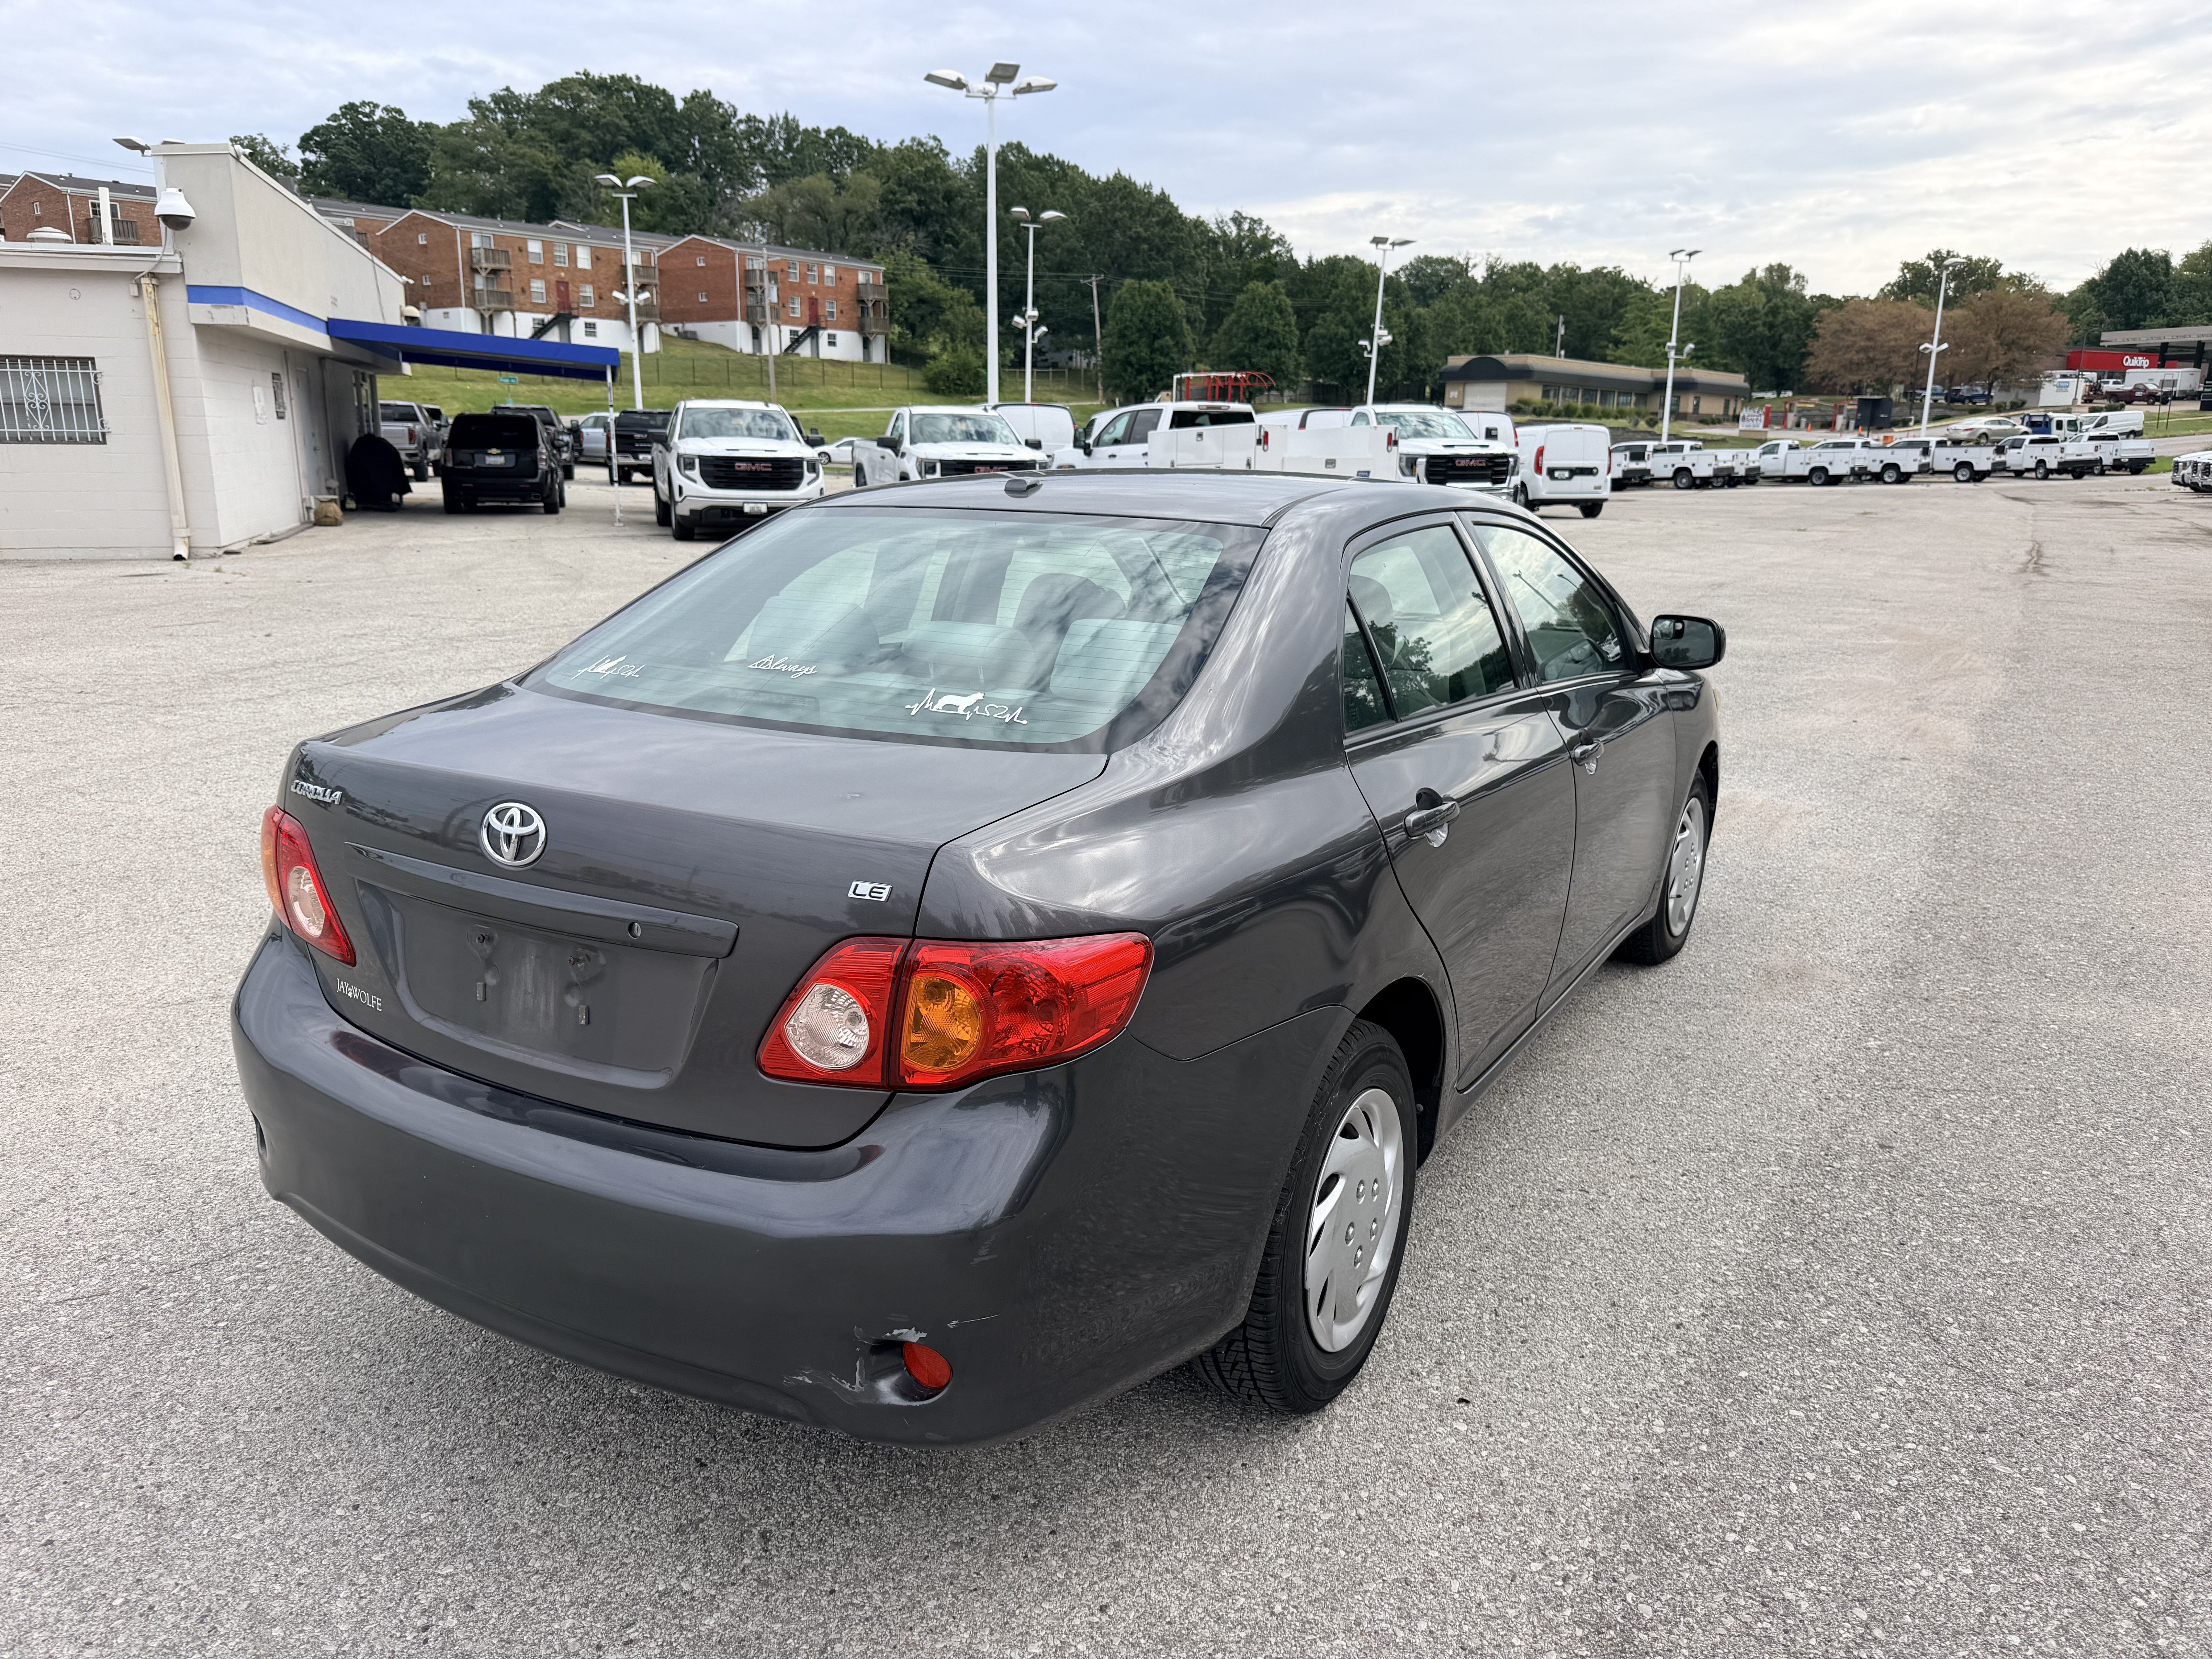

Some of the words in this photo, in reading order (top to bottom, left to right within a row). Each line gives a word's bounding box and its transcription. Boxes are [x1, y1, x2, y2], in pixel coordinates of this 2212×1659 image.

[2123, 355, 2149, 369] QuikTrip
[735, 462, 772, 471] GMC
[290, 780, 342, 805] COROLLA
[852, 883, 887, 899] LE
[337, 978, 349, 994] JAY
[351, 985, 382, 1012] WOLFE
